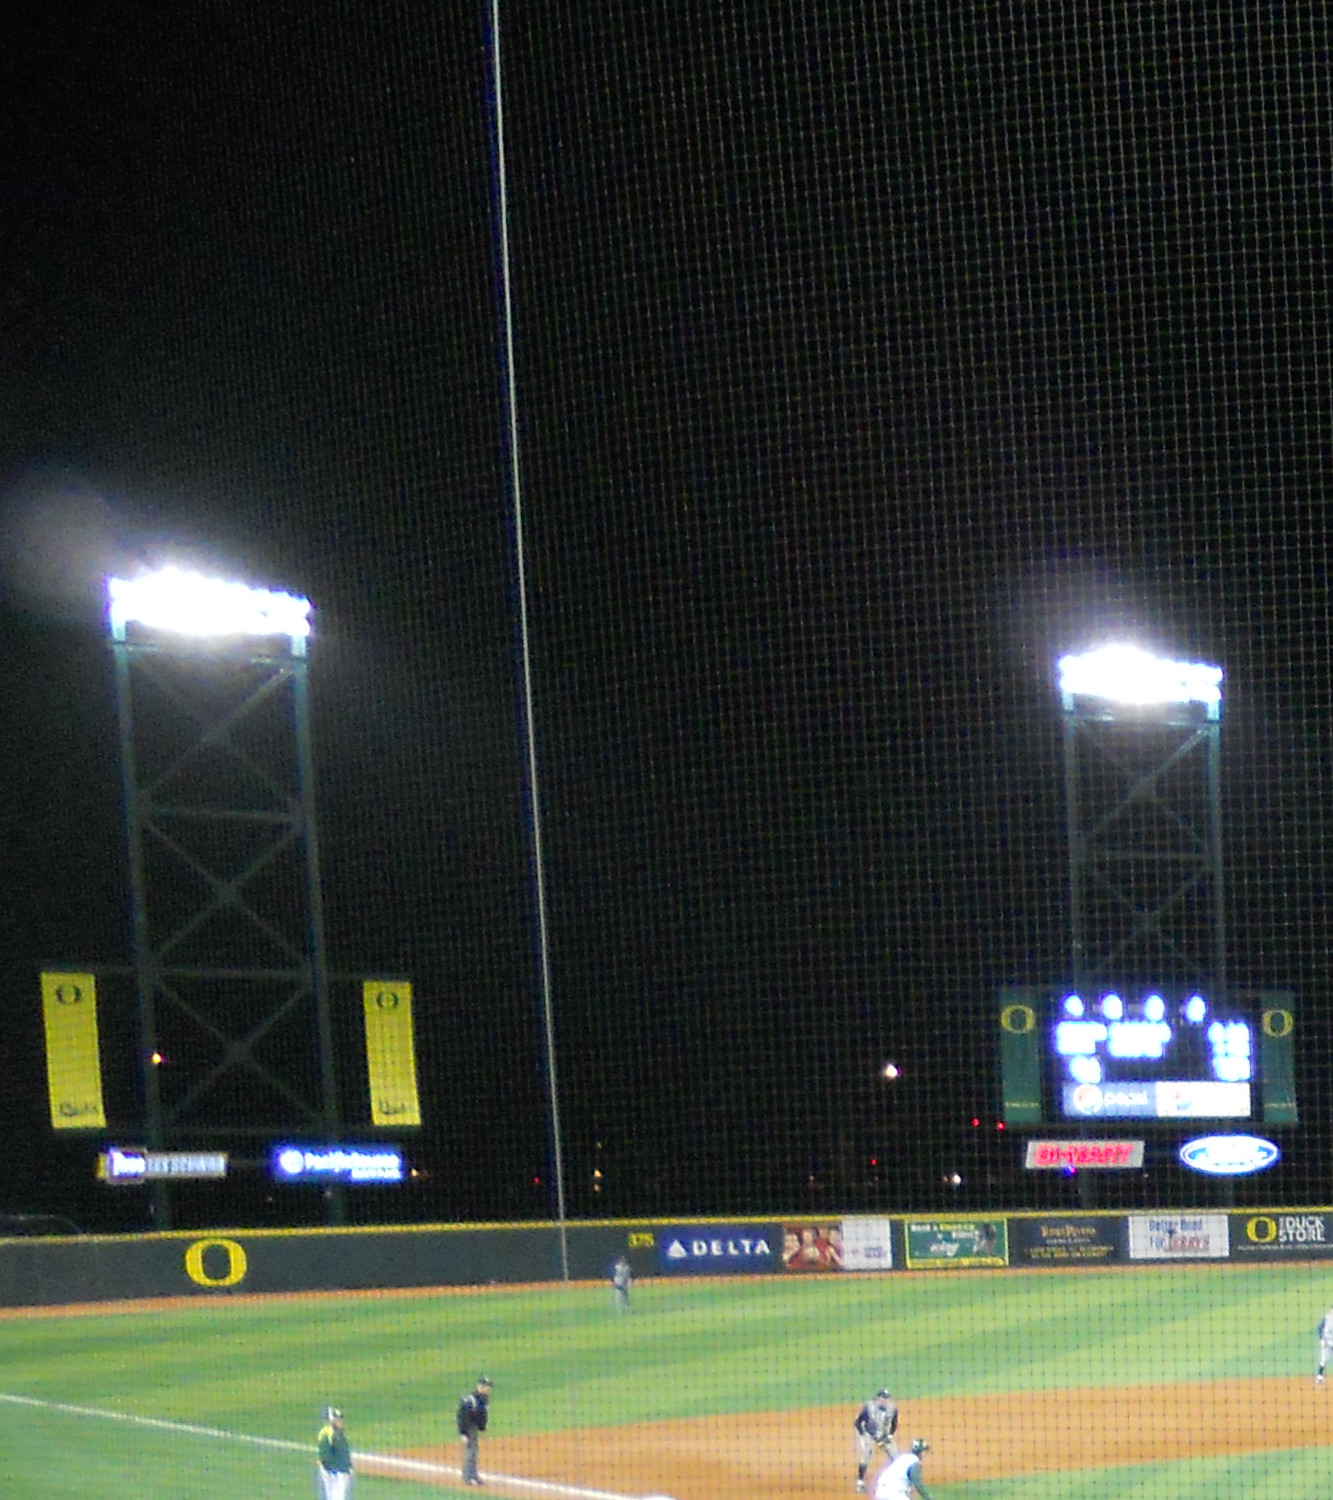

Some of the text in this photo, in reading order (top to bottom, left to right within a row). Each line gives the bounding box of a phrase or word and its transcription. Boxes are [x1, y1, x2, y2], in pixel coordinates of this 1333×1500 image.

[1001, 1005, 1035, 1033] O
[1262, 1009, 1294, 1036] O
[1285, 1216, 1324, 1229] DUCK
[1278, 1229, 1325, 1242] STORE
[692, 1240, 770, 1257] DELTA
[185, 1238, 248, 1287] O
